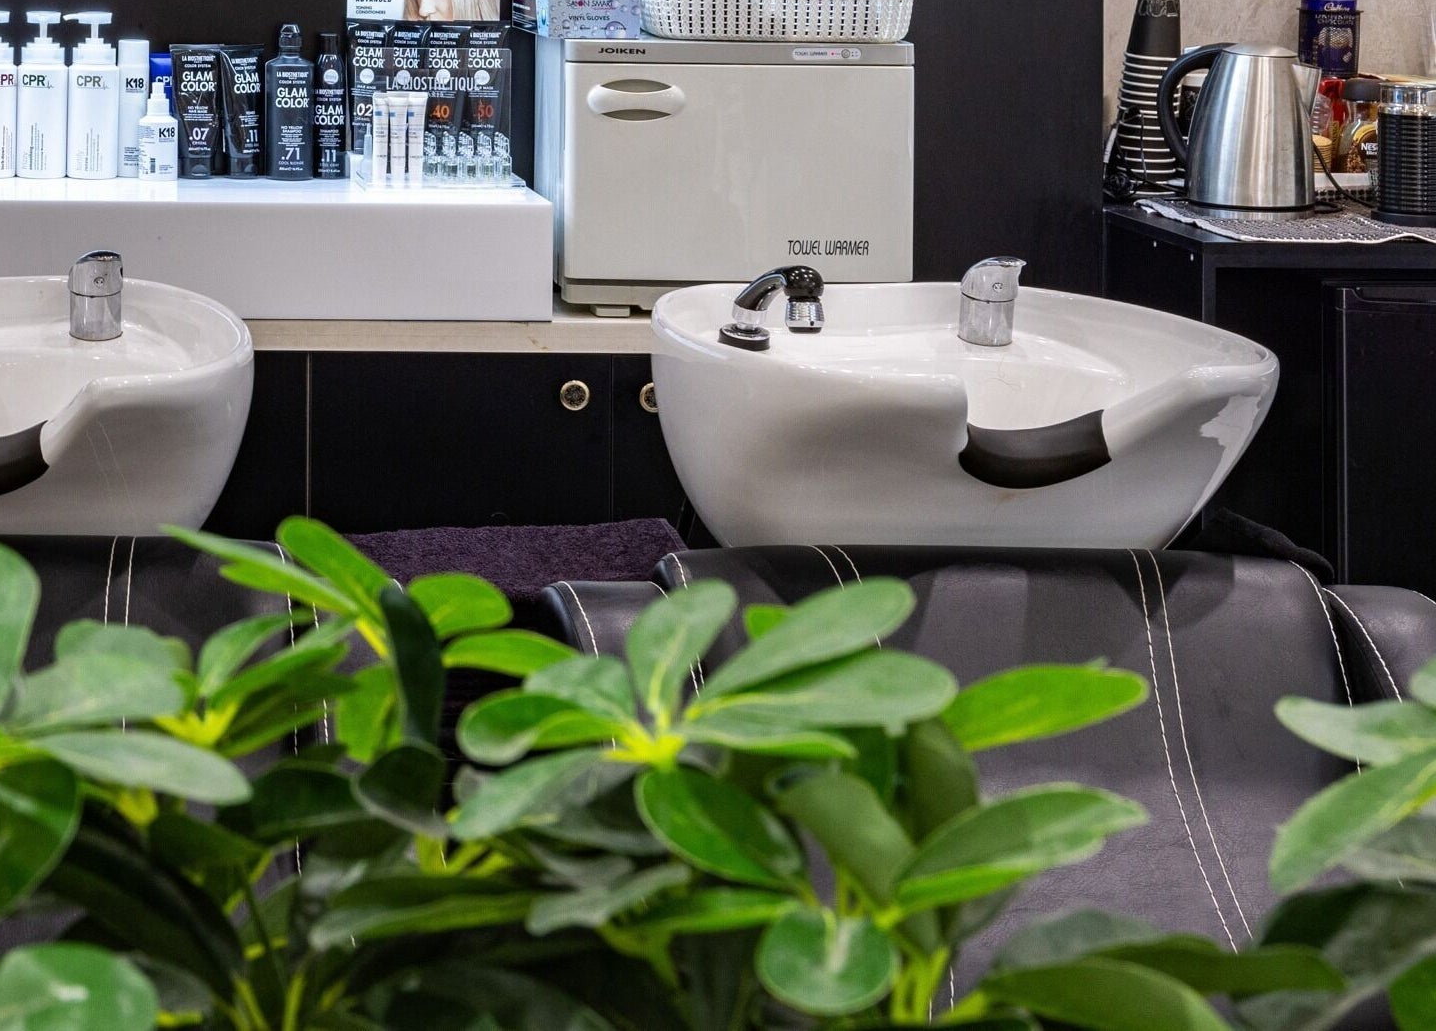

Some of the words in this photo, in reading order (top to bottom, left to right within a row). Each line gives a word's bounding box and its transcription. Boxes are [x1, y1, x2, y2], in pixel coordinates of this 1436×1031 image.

[355, 46, 383, 58] GLAM
[393, 47, 418, 58] GLAM
[429, 48, 457, 59] GLAM
[468, 48, 499, 59] GLAM
[598, 47, 646, 55] JOIKEN
[352, 56, 384, 68] COLOR
[393, 57, 419, 69] OLOR
[22, 74, 46, 86] CPR
[76, 75, 102, 87] CPR
[182, 71, 213, 82] GLAM
[234, 72, 259, 84] GLAM
[126, 77, 144, 89] K18
[181, 81, 216, 92] COLOR
[234, 83, 261, 94] COLOR
[277, 87, 307, 98] GLAM
[275, 98, 309, 109] COLOR
[315, 105, 343, 115] GLAM
[353, 103, 373, 117] .02
[314, 115, 344, 126] COLOR
[158, 127, 176, 138] K18
[189, 127, 210, 141] .07
[246, 129, 258, 143] .11
[281, 147, 300, 161] .71
[321, 149, 337, 163] .11
[787, 239, 822, 256] TOWEL
[824, 239, 869, 256] WARMER
